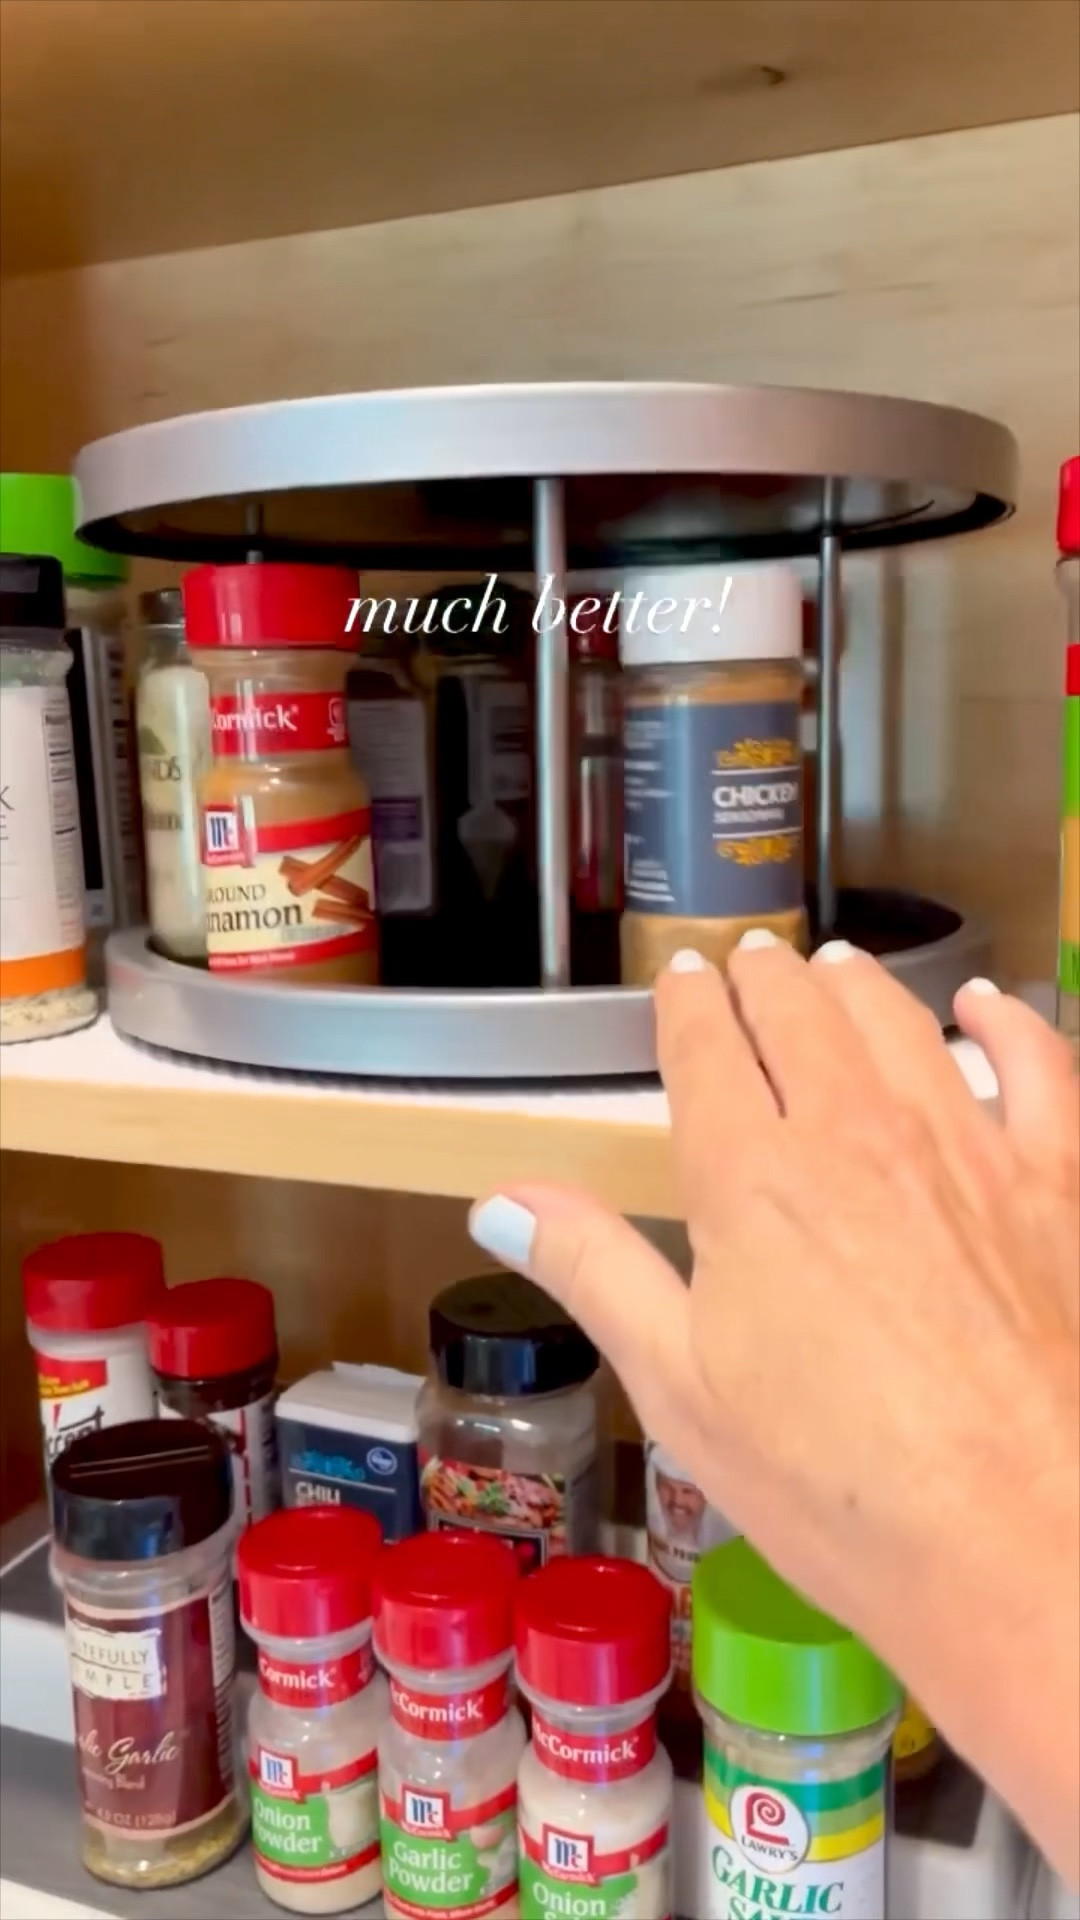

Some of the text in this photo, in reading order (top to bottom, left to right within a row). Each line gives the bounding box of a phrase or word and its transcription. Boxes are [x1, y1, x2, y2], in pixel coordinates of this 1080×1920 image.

[105, 1730, 181, 1775] Garlic
[254, 1797, 311, 1831] Onion
[393, 1841, 462, 1870] Garlic
[741, 1834, 799, 1862] LAWRY'S
[389, 1855, 474, 1894] Powder
[711, 1844, 845, 1914] GARLIC
[532, 1881, 607, 1917] Onion
